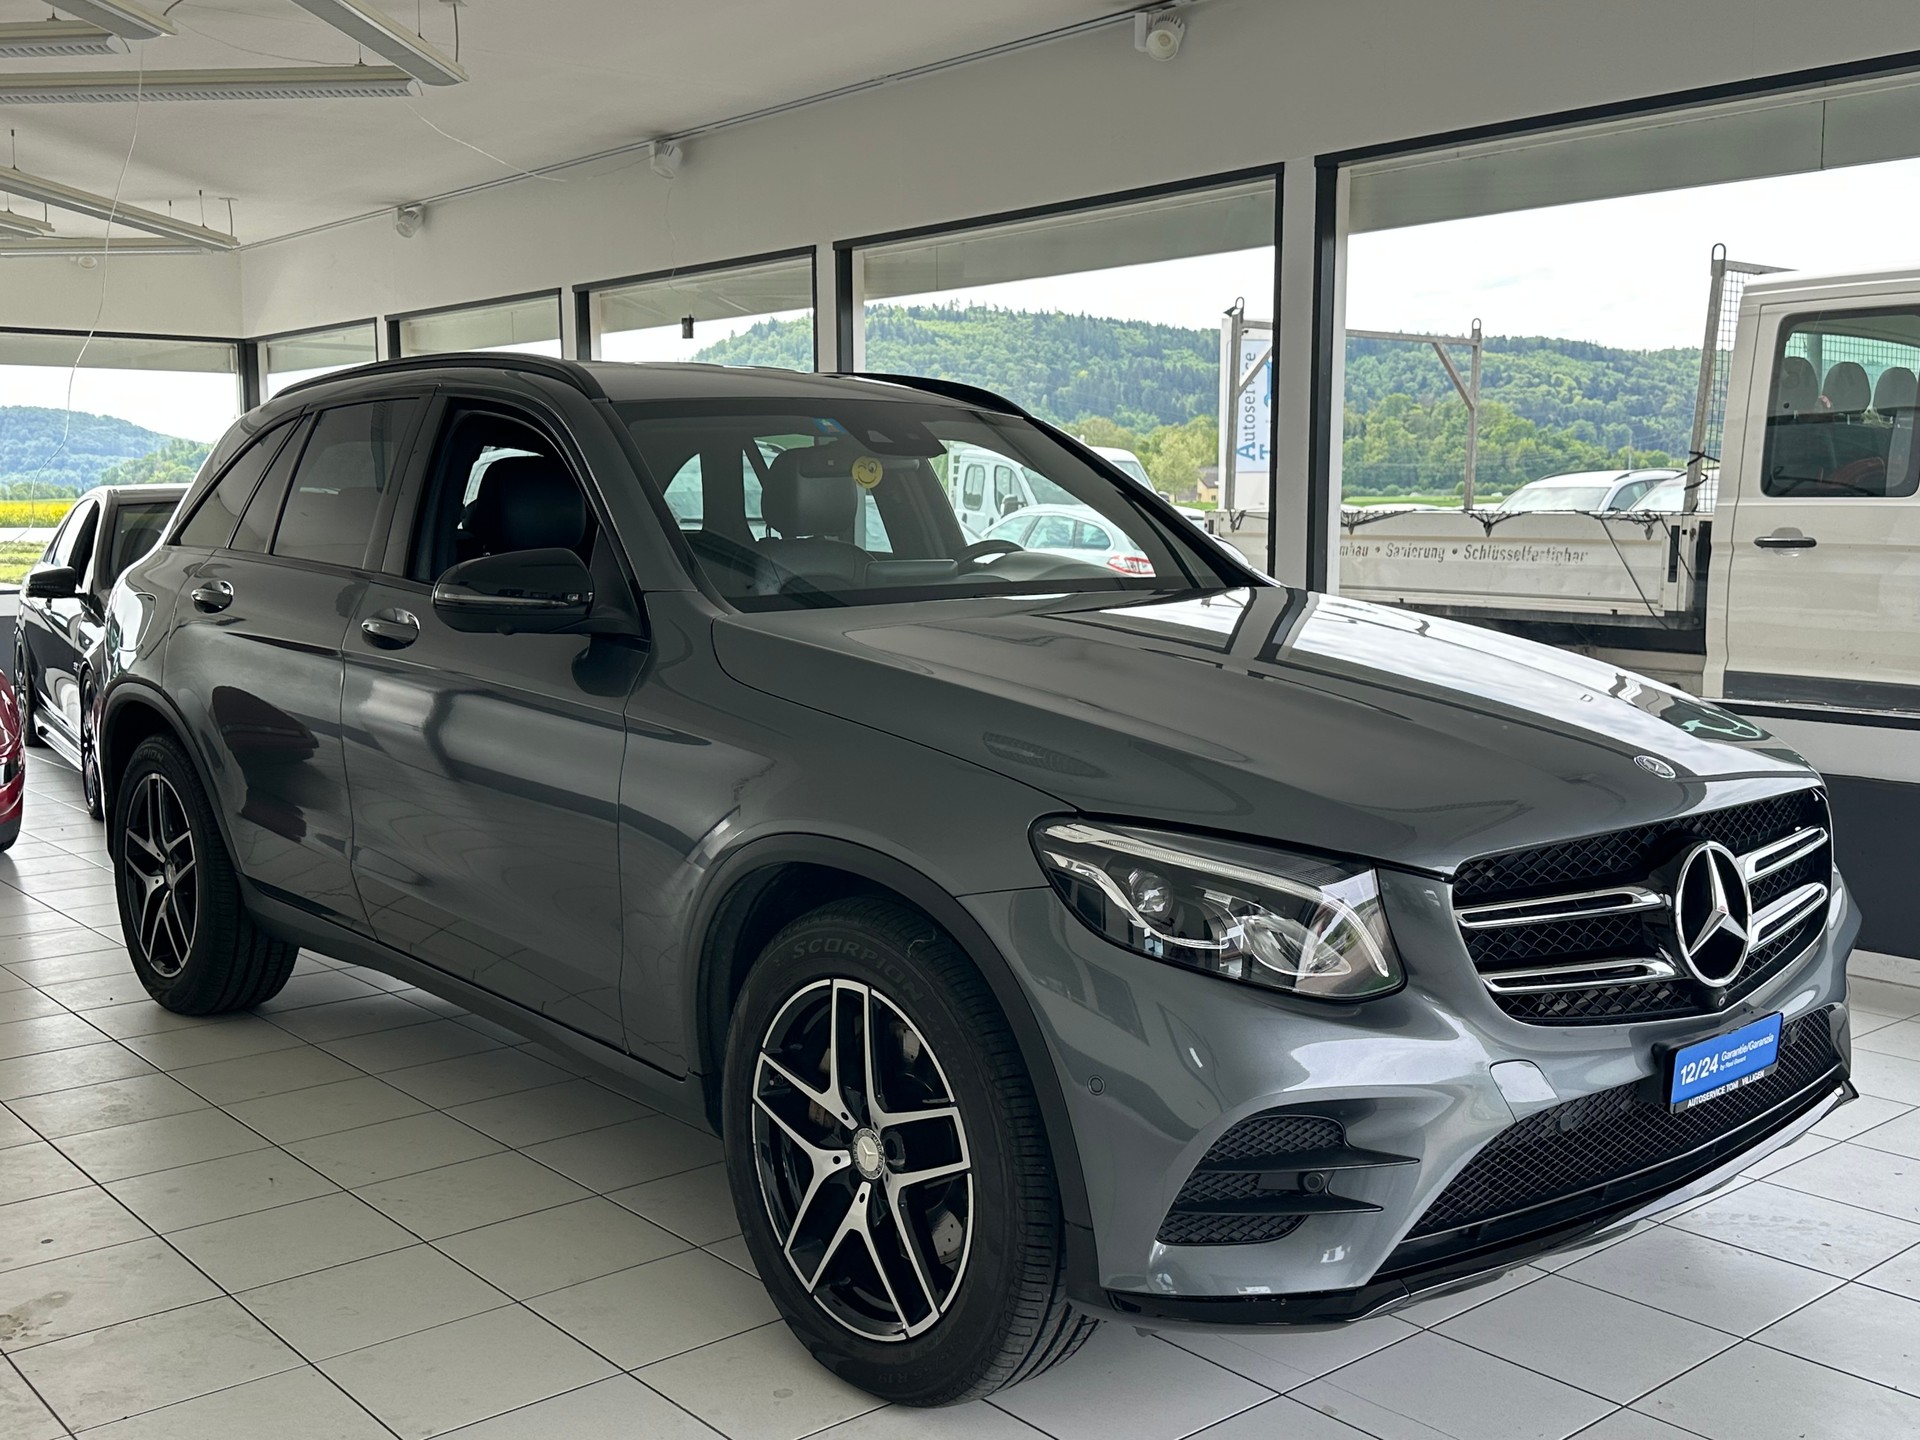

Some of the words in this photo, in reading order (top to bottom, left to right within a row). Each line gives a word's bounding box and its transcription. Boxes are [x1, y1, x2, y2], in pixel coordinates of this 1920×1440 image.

[1236, 352, 1256, 461] Autosere
[1339, 541, 1369, 557] mbau
[1386, 542, 1446, 563] Sanierung
[793, 938, 925, 1001] SCORPION
[1680, 1053, 1719, 1086] 12/24
[1687, 1085, 1726, 1108] AUTOSERVICE
[1726, 1080, 1739, 1092] TONI
